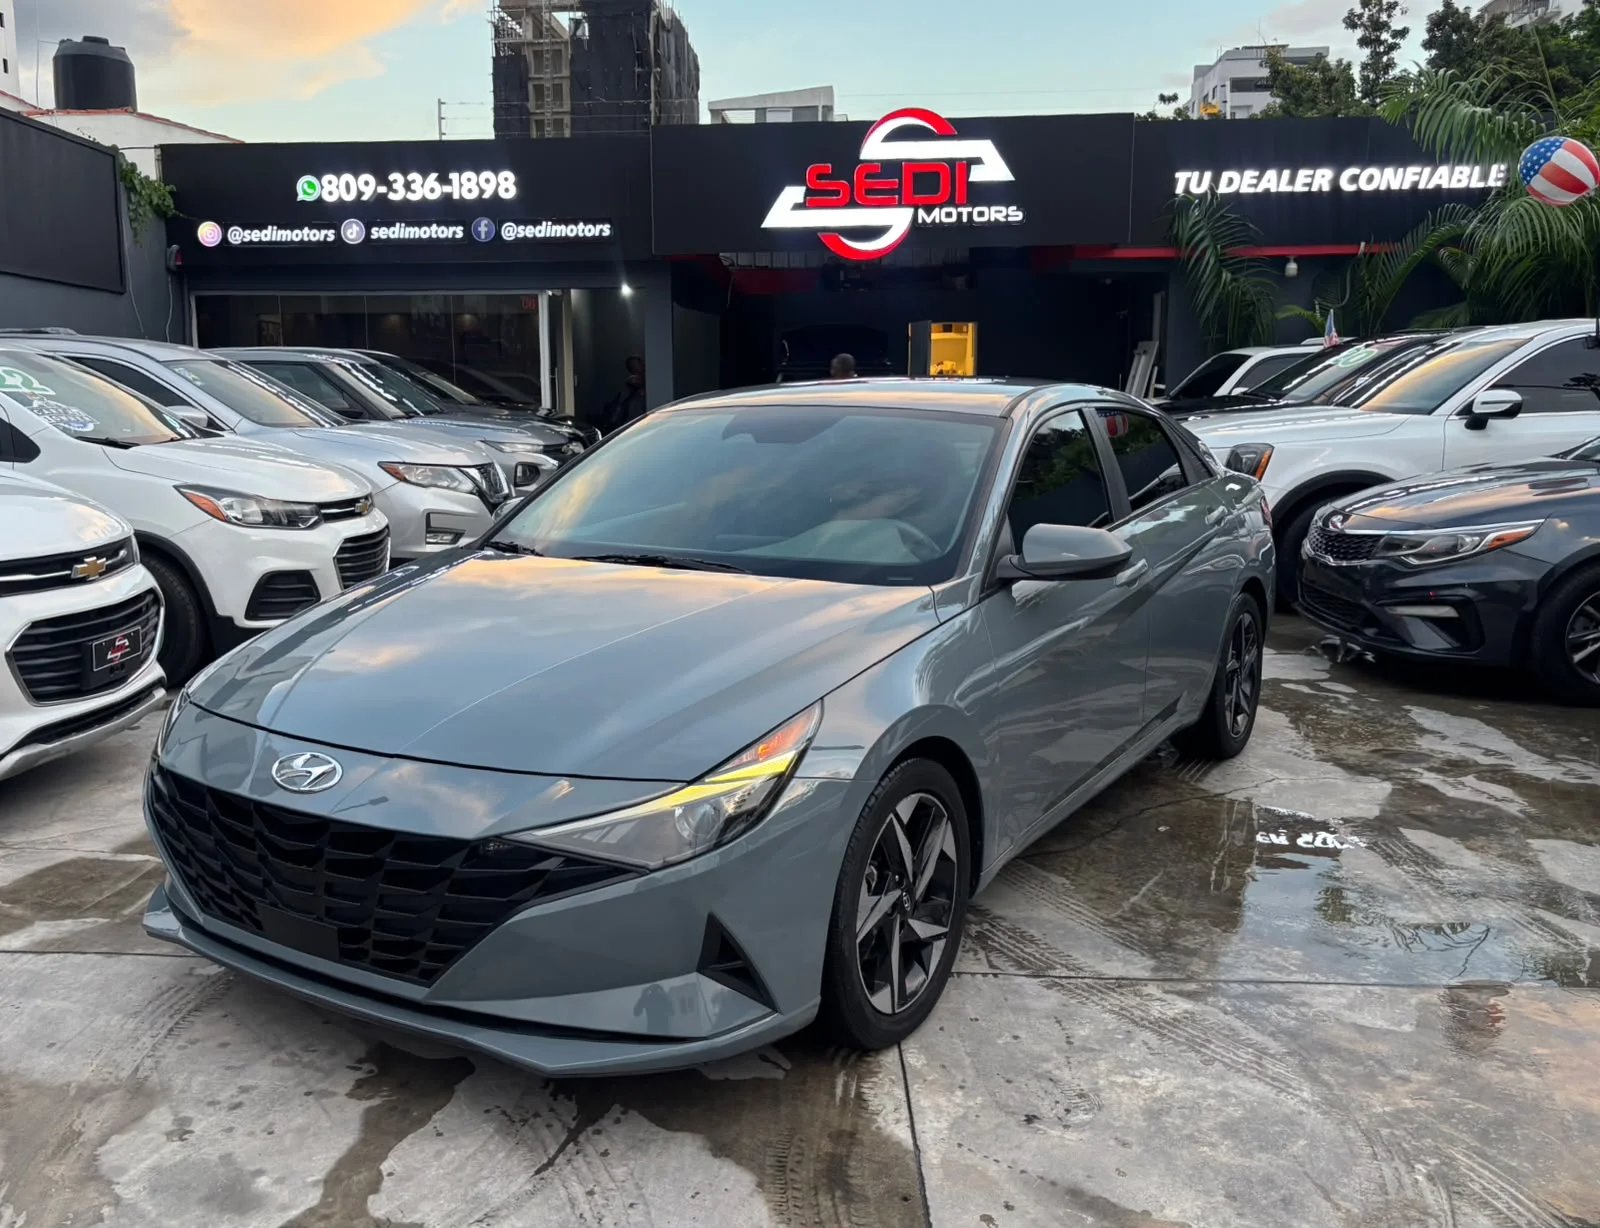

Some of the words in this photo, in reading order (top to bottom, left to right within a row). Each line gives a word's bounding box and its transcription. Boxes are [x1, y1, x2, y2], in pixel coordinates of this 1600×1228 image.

[321, 170, 517, 202] 809-336-1898
[806, 162, 968, 208] SEDI
[1174, 170, 1212, 194] TU
[1217, 168, 1334, 193] DEALER
[1339, 163, 1507, 192] CONFIABLE
[917, 205, 1024, 224] MOTORS
[227, 226, 336, 245] @sedimotors
[370, 222, 464, 241] sedimotors
[501, 221, 611, 241] @sedimotors
